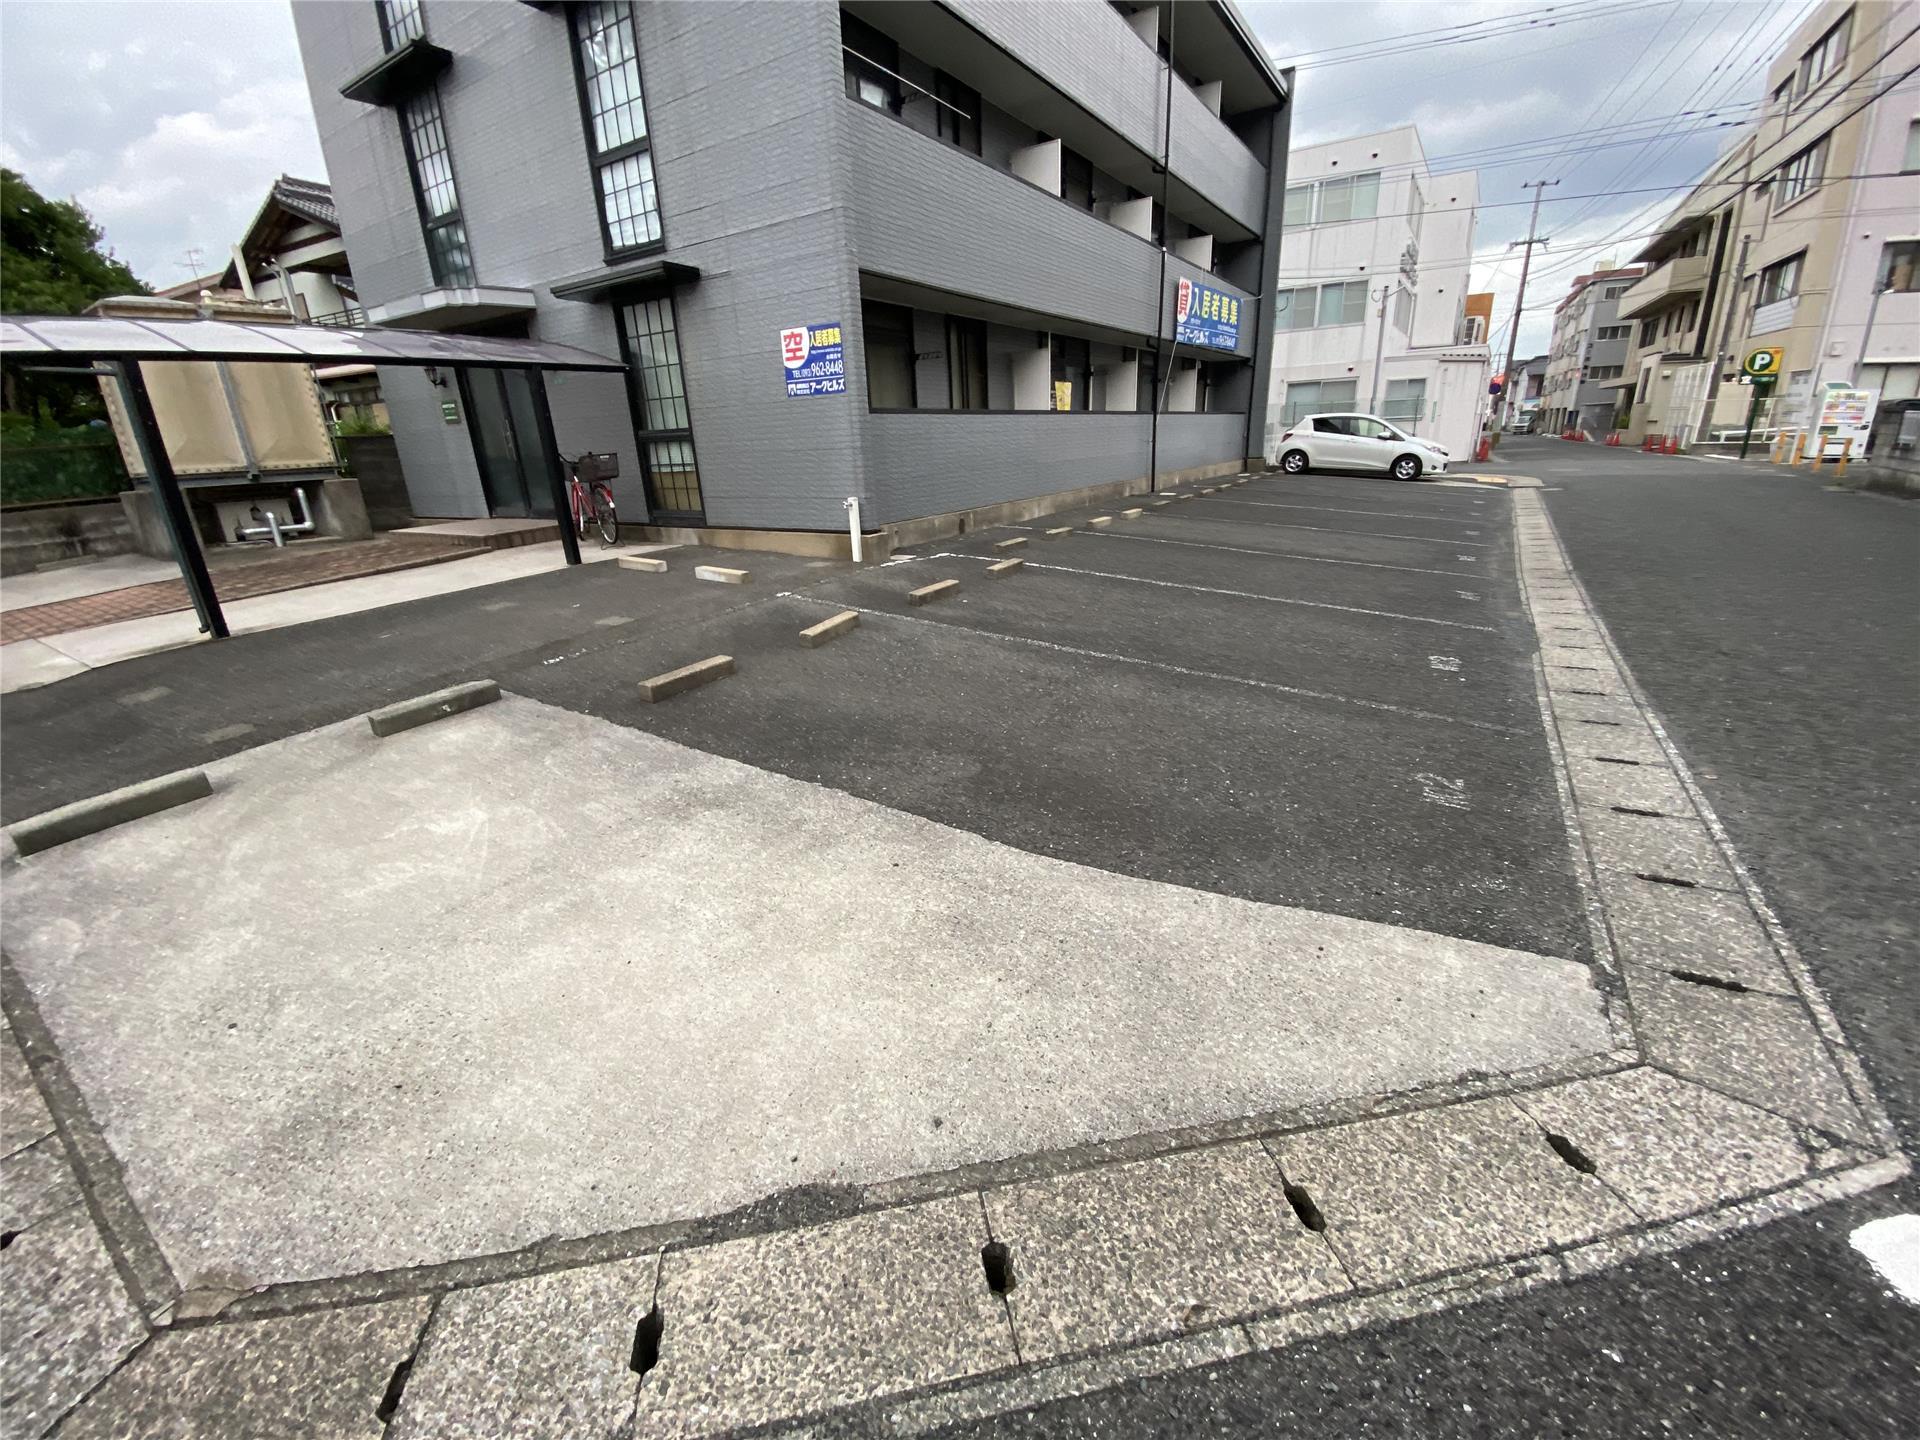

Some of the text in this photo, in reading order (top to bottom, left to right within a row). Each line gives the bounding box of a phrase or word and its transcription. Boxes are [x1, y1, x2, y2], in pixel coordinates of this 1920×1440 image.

[1191, 287, 1239, 326] 入居者募集
[783, 331, 805, 362] 空
[811, 360, 844, 377] 962-8448
[1753, 353, 1771, 370] P
[810, 378, 845, 393] アークヒルズ
